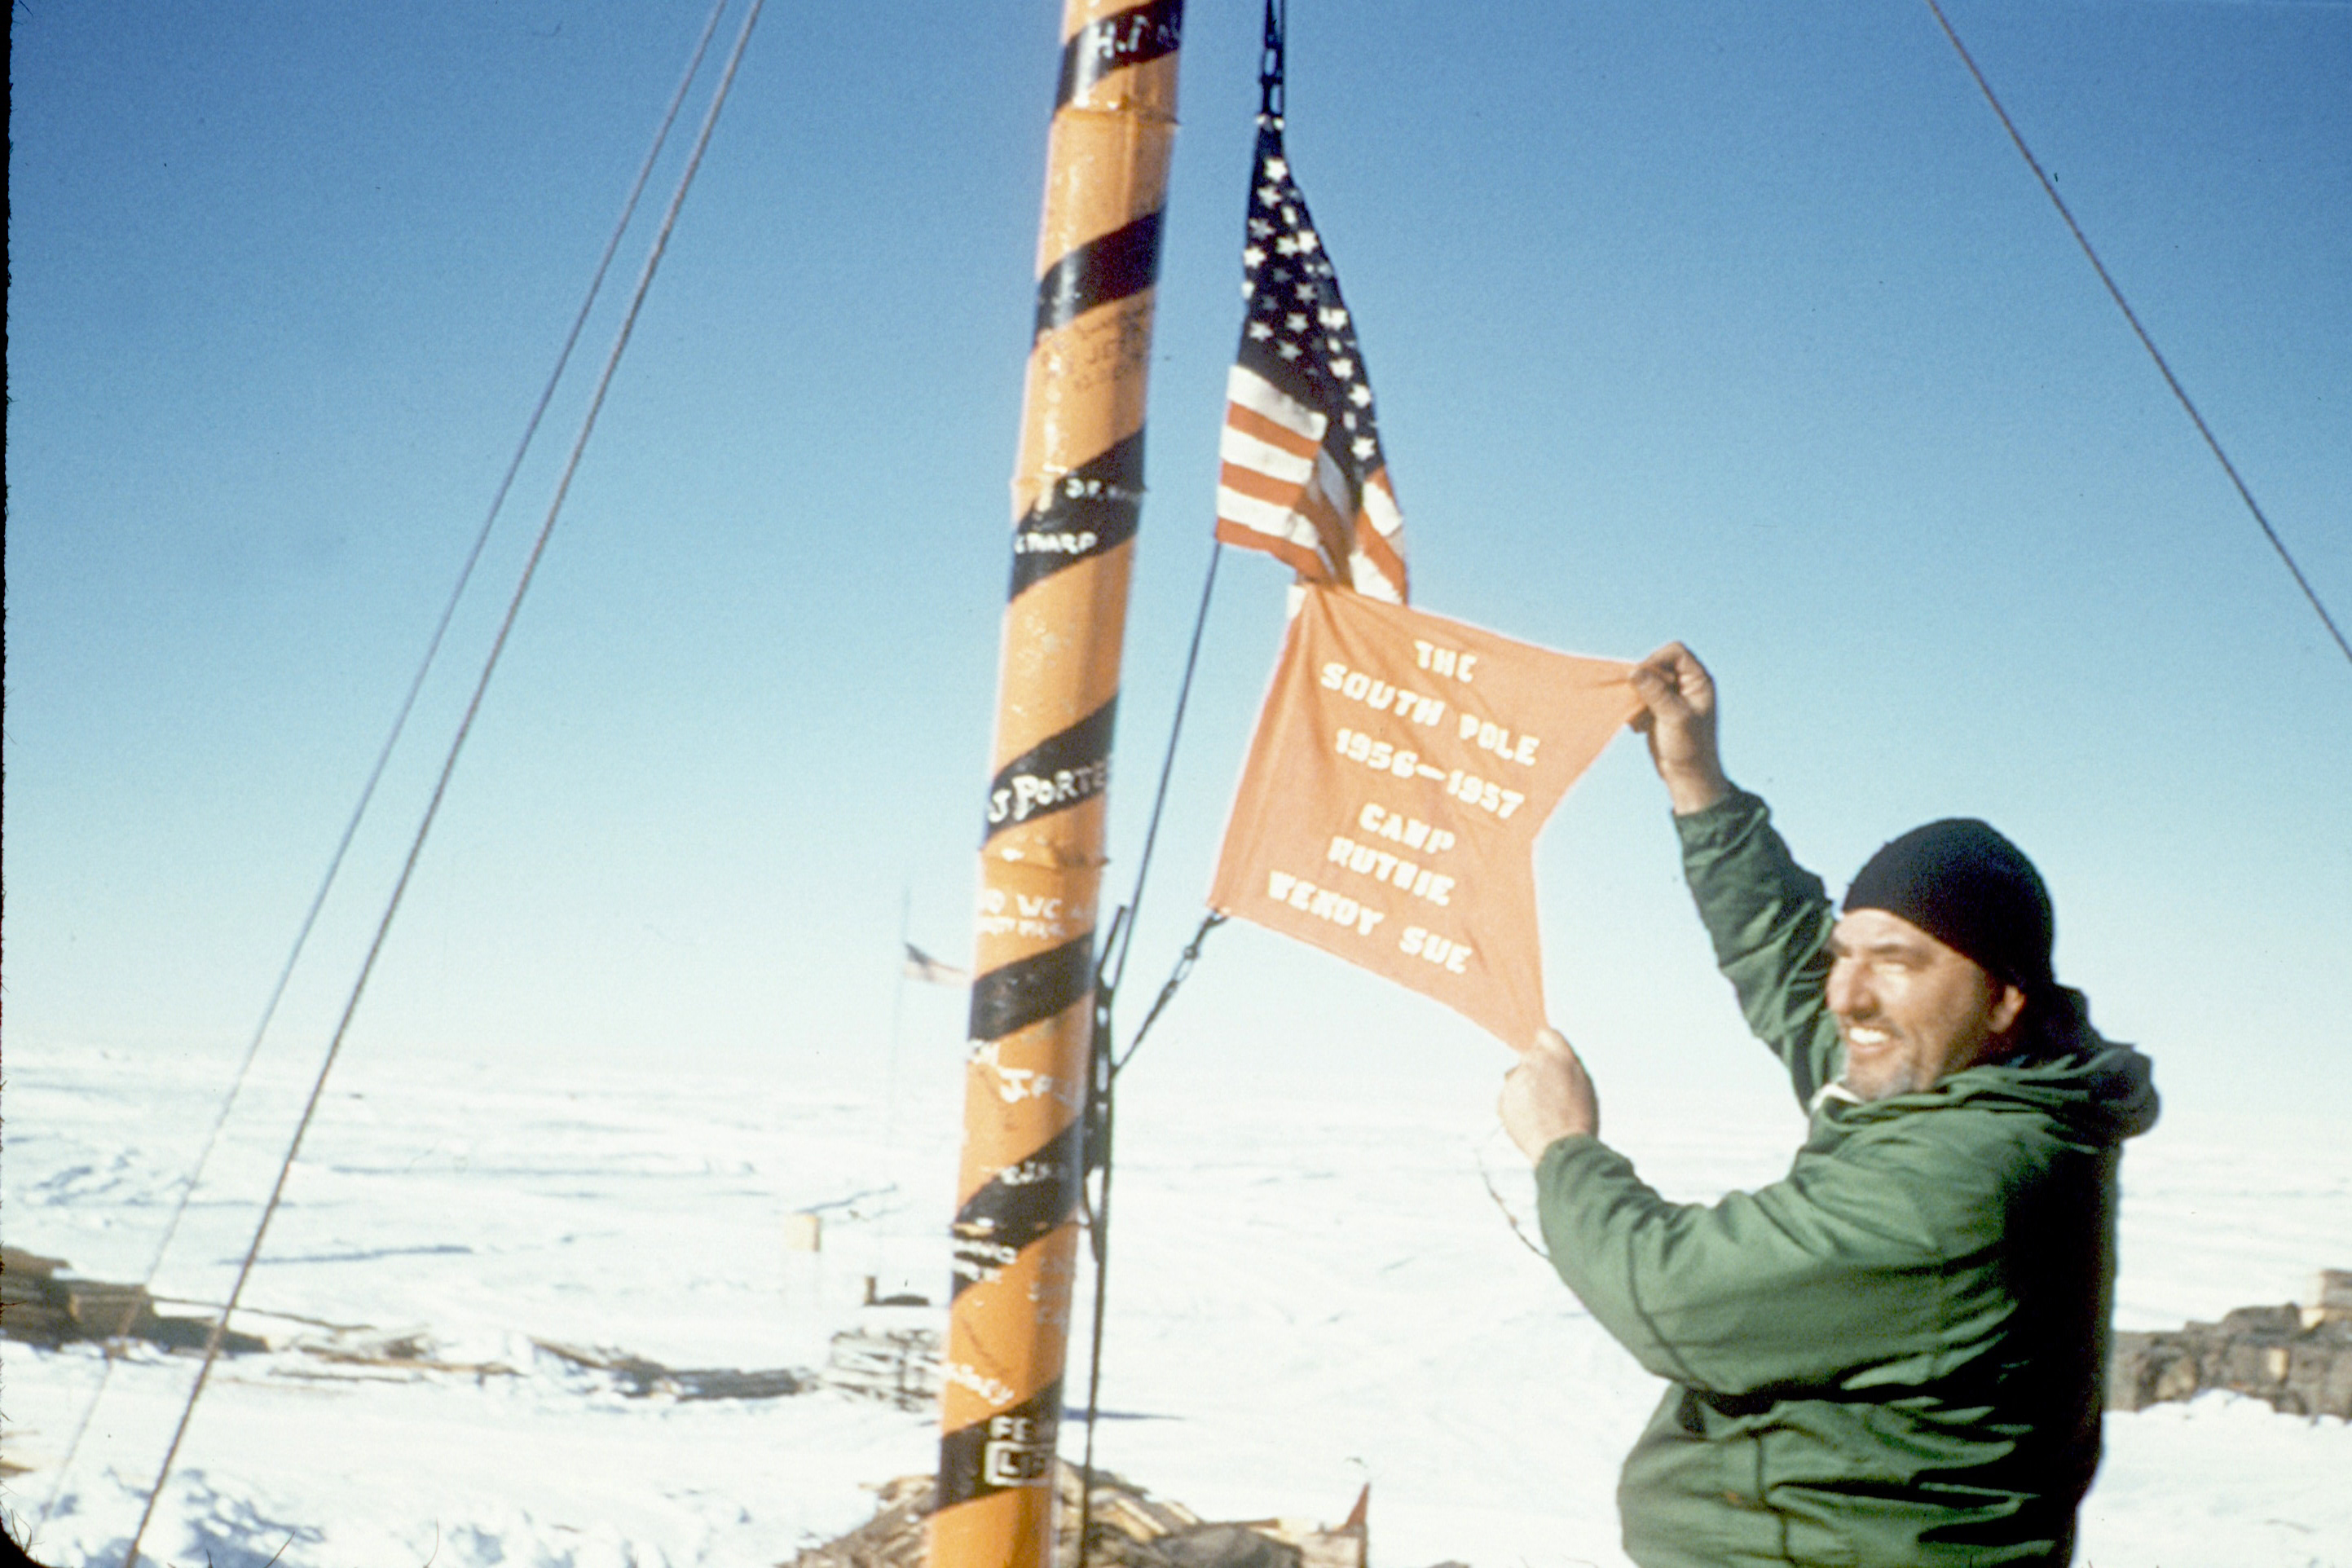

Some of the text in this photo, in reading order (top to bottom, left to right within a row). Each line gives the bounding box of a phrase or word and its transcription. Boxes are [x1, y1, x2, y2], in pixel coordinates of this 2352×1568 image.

[1415, 641, 1478, 681] THE
[1321, 663, 1540, 765] SOUTH POLE
[1336, 729, 1525, 818] 1956-1957
[1359, 804, 1456, 853] CAMP
[1328, 838, 1455, 905] RUTHIE
[1269, 872, 1472, 973] WENDY SUE
